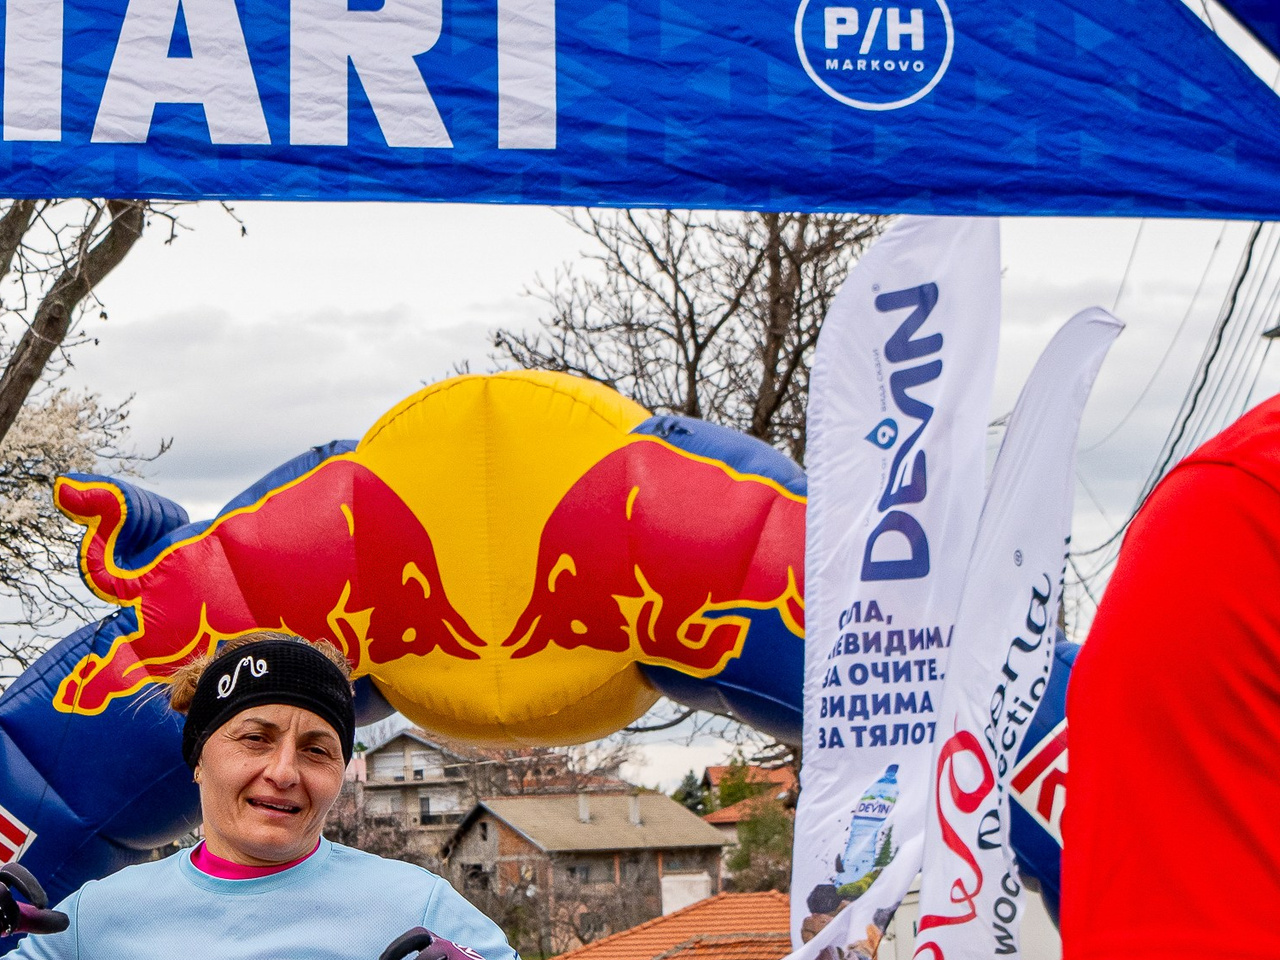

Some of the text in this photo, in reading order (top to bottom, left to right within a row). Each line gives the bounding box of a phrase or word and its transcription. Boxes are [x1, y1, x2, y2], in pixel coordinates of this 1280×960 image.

[823, 7, 924, 54] P/H
[825, 59, 925, 72] MARKOVO
[820, 690, 934, 721] ВИДИМА
[818, 727, 845, 749] ЗА
